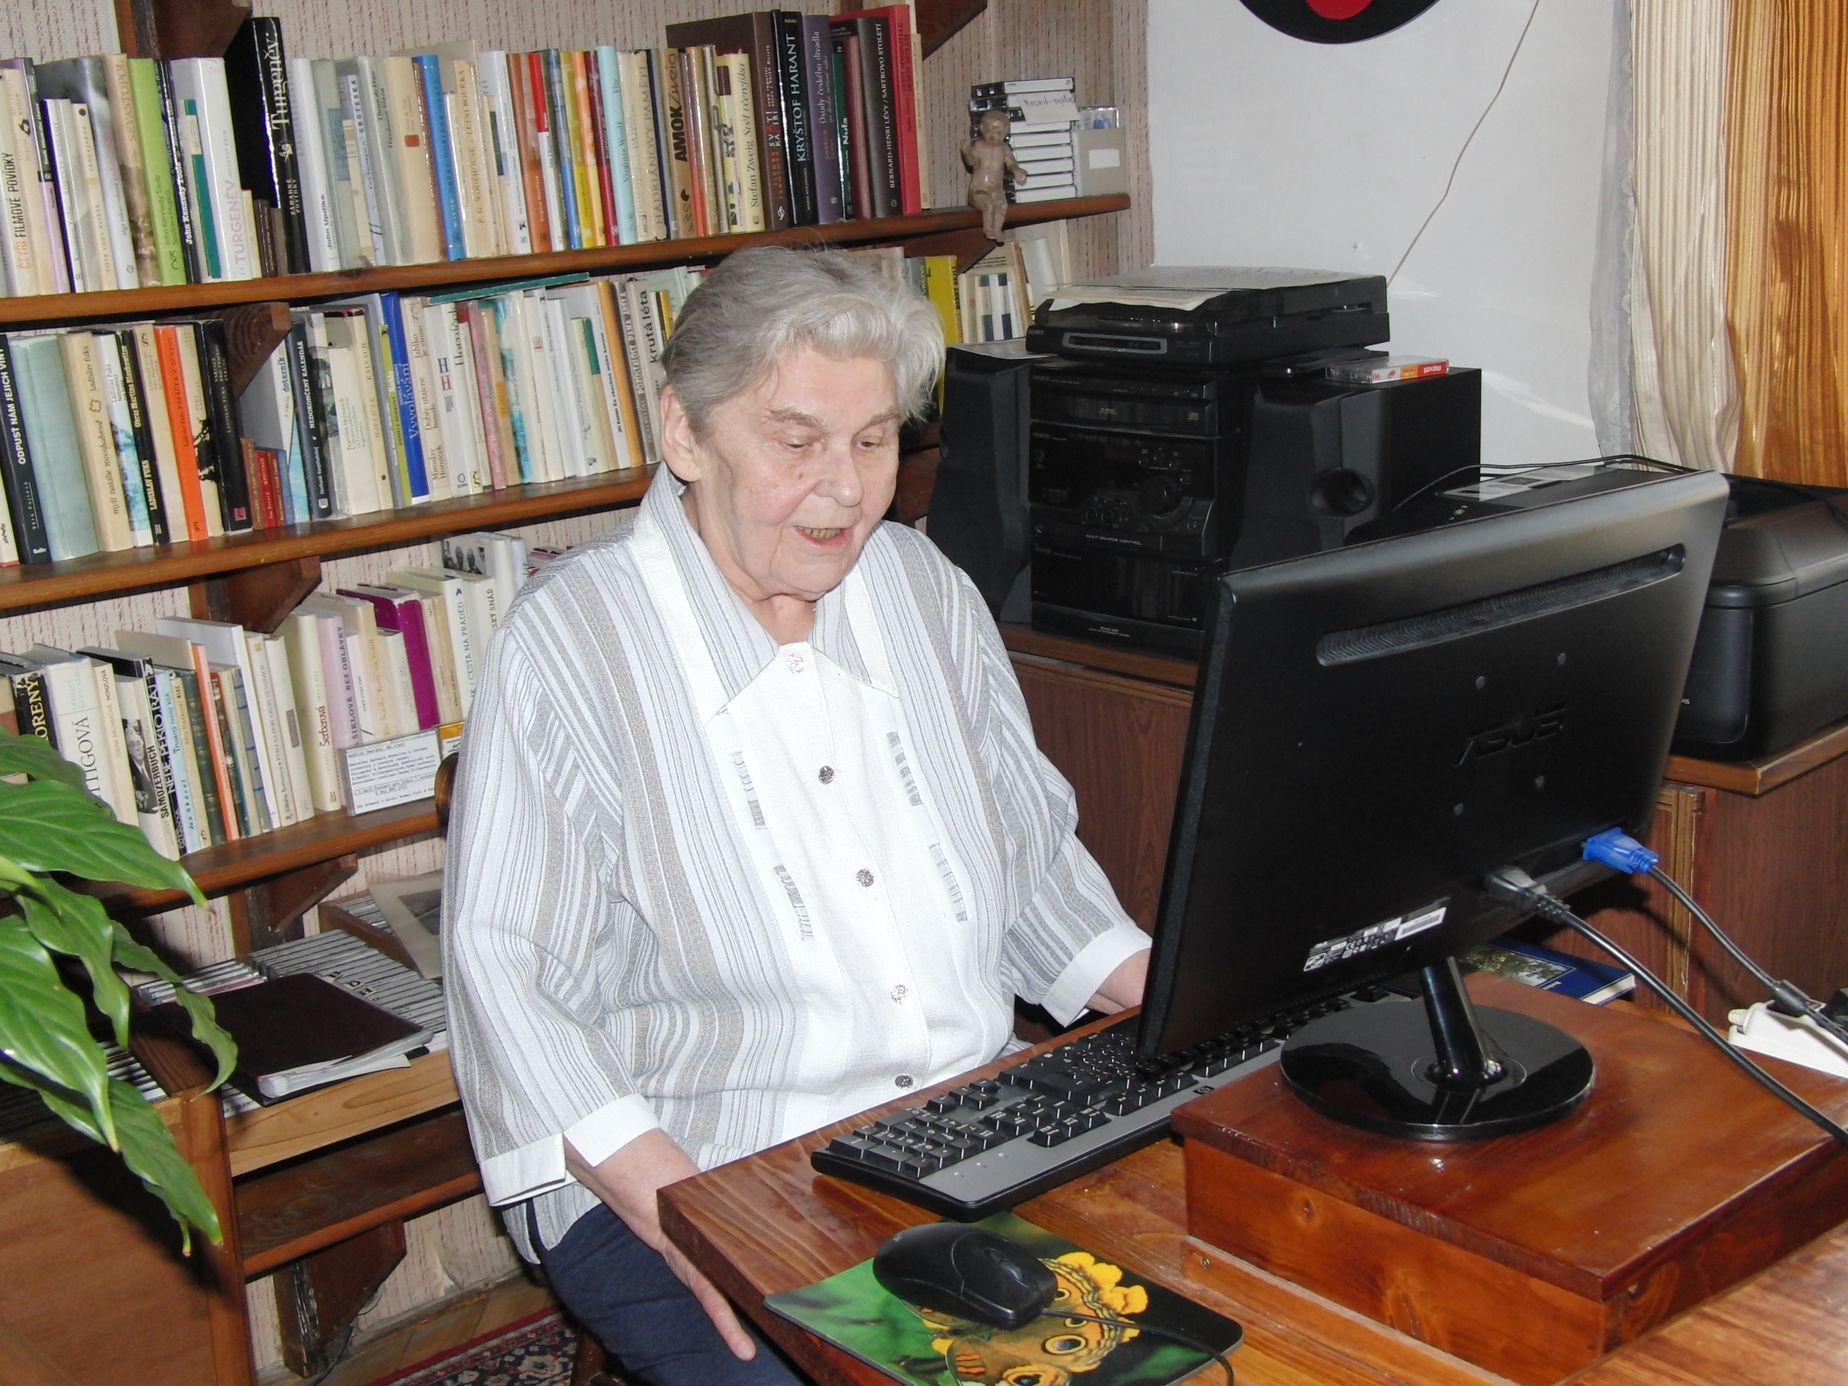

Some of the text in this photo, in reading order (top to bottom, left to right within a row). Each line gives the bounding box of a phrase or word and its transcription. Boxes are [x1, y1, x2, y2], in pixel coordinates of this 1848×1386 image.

[875, 24, 884, 55] STOLETÍ
[813, 31, 827, 124] Osudy českého divadla
[878, 56, 889, 98] SARTROVO
[785, 33, 806, 162] KRYŠTOF HARANT
[882, 105, 890, 124] LÉVY
[616, 121, 626, 147] Woolf
[669, 105, 688, 162] AMOK
[3, 152, 18, 193] POVÍDKY
[620, 148, 629, 182] Virginia
[743, 140, 756, 172] Zweig
[885, 125, 896, 188] BERNARD-HENRI
[645, 127, 663, 224] HADRIÁNOVY
[747, 175, 759, 207] Stefan
[8, 197, 27, 238] FILMOVÉ
[175, 161, 194, 245] John Kennedy Toole
[225, 180, 246, 264] TURGENĚV
[320, 194, 333, 250] John Updike
[640, 290, 658, 364] krutá léta
[82, 345, 91, 362] fuks
[411, 334, 422, 358] Jablko
[2, 371, 16, 402] JEJICH
[277, 356, 290, 393] dotazník
[297, 340, 315, 429] NEDOKONČENÝ KALENDÁŘ
[418, 377, 429, 404] utajené
[8, 403, 19, 425] NÁM
[128, 383, 138, 409] Martina
[400, 362, 420, 439] Vyvolávání
[132, 409, 141, 428] Obraz
[11, 426, 27, 465] ODPUSŤ
[430, 448, 439, 480] Miroslav
[105, 469, 116, 495] natálie
[142, 459, 157, 510] LADISLAV FUKS
[457, 601, 468, 636] PRADĚD
[337, 625, 348, 671] OHLÁVKY
[463, 638, 471, 651] NA
[100, 669, 111, 701] HONZLOVÁ
[464, 653, 475, 680] CESTA
[27, 678, 49, 743] OŘENY
[347, 696, 358, 739] ŠIKLOVÁ
